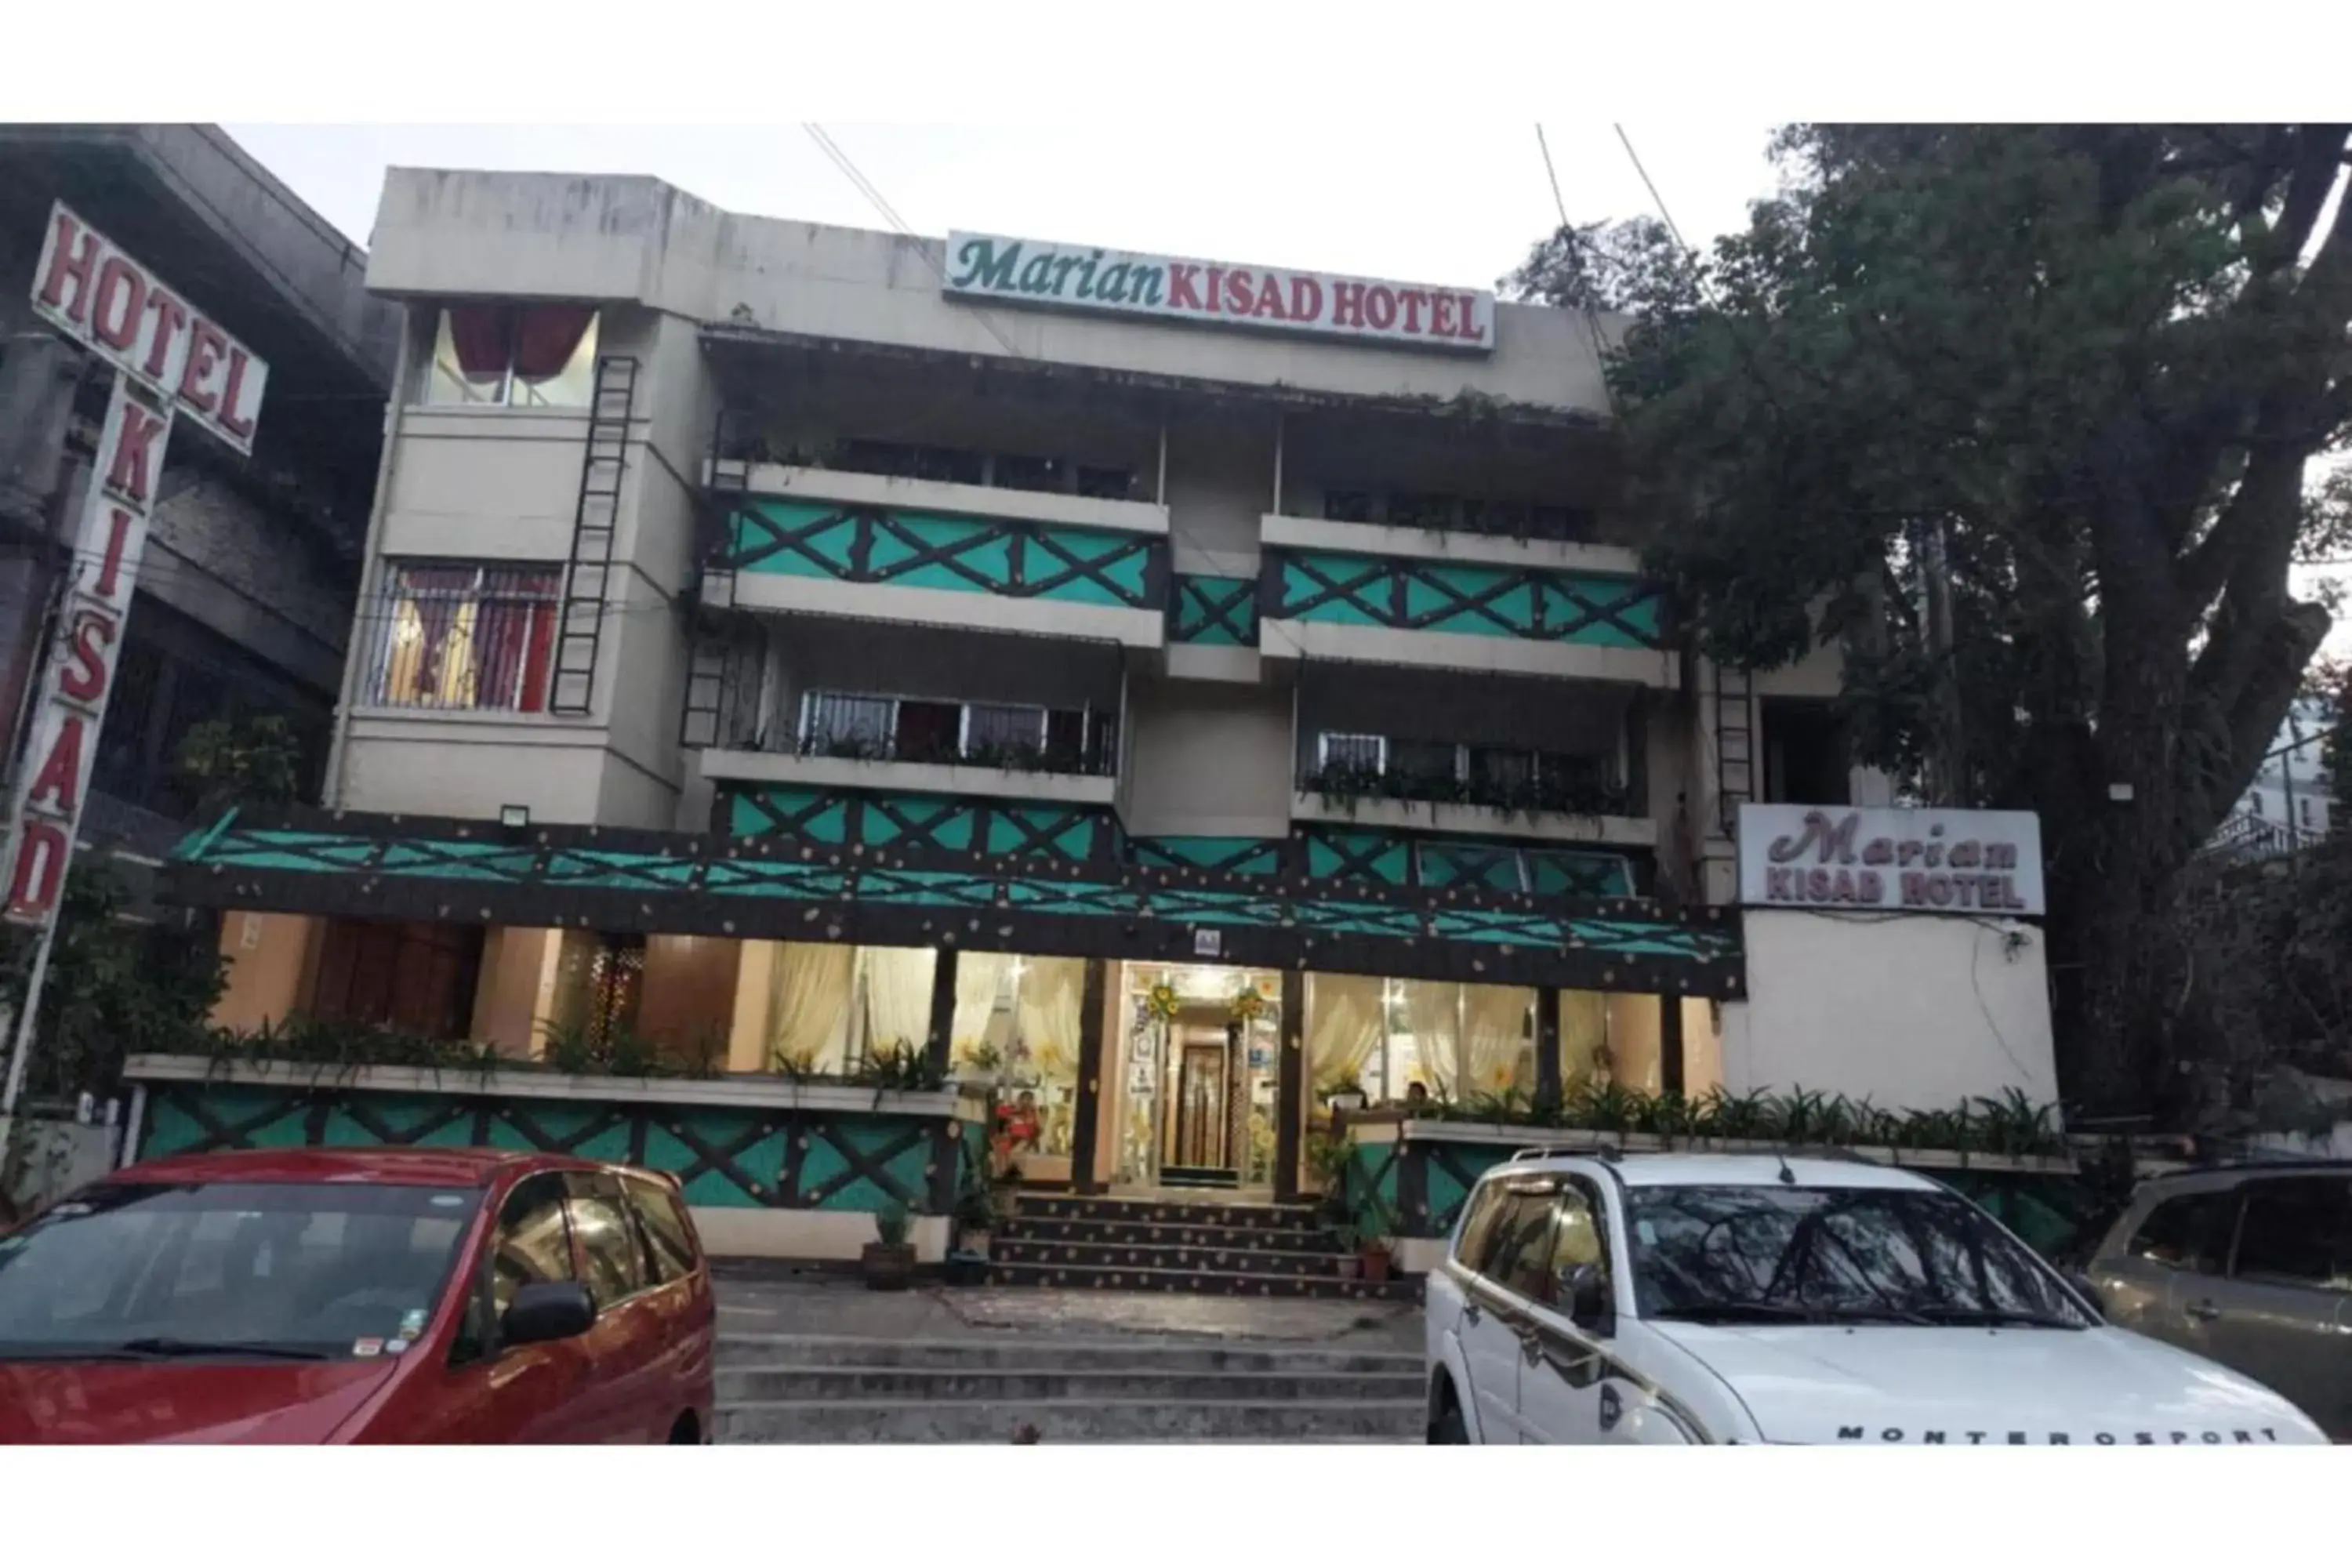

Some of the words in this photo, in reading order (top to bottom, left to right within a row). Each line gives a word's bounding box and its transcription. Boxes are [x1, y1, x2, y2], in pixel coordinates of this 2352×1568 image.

[39, 213, 253, 437] HOTEL
[951, 238, 1167, 306] Marian
[1166, 263, 1323, 324] KISAD
[1333, 281, 1485, 342] HOTEL
[8, 401, 163, 914] KISAD
[1767, 810, 2018, 869] Marian
[1898, 872, 2026, 909] HOTEL
